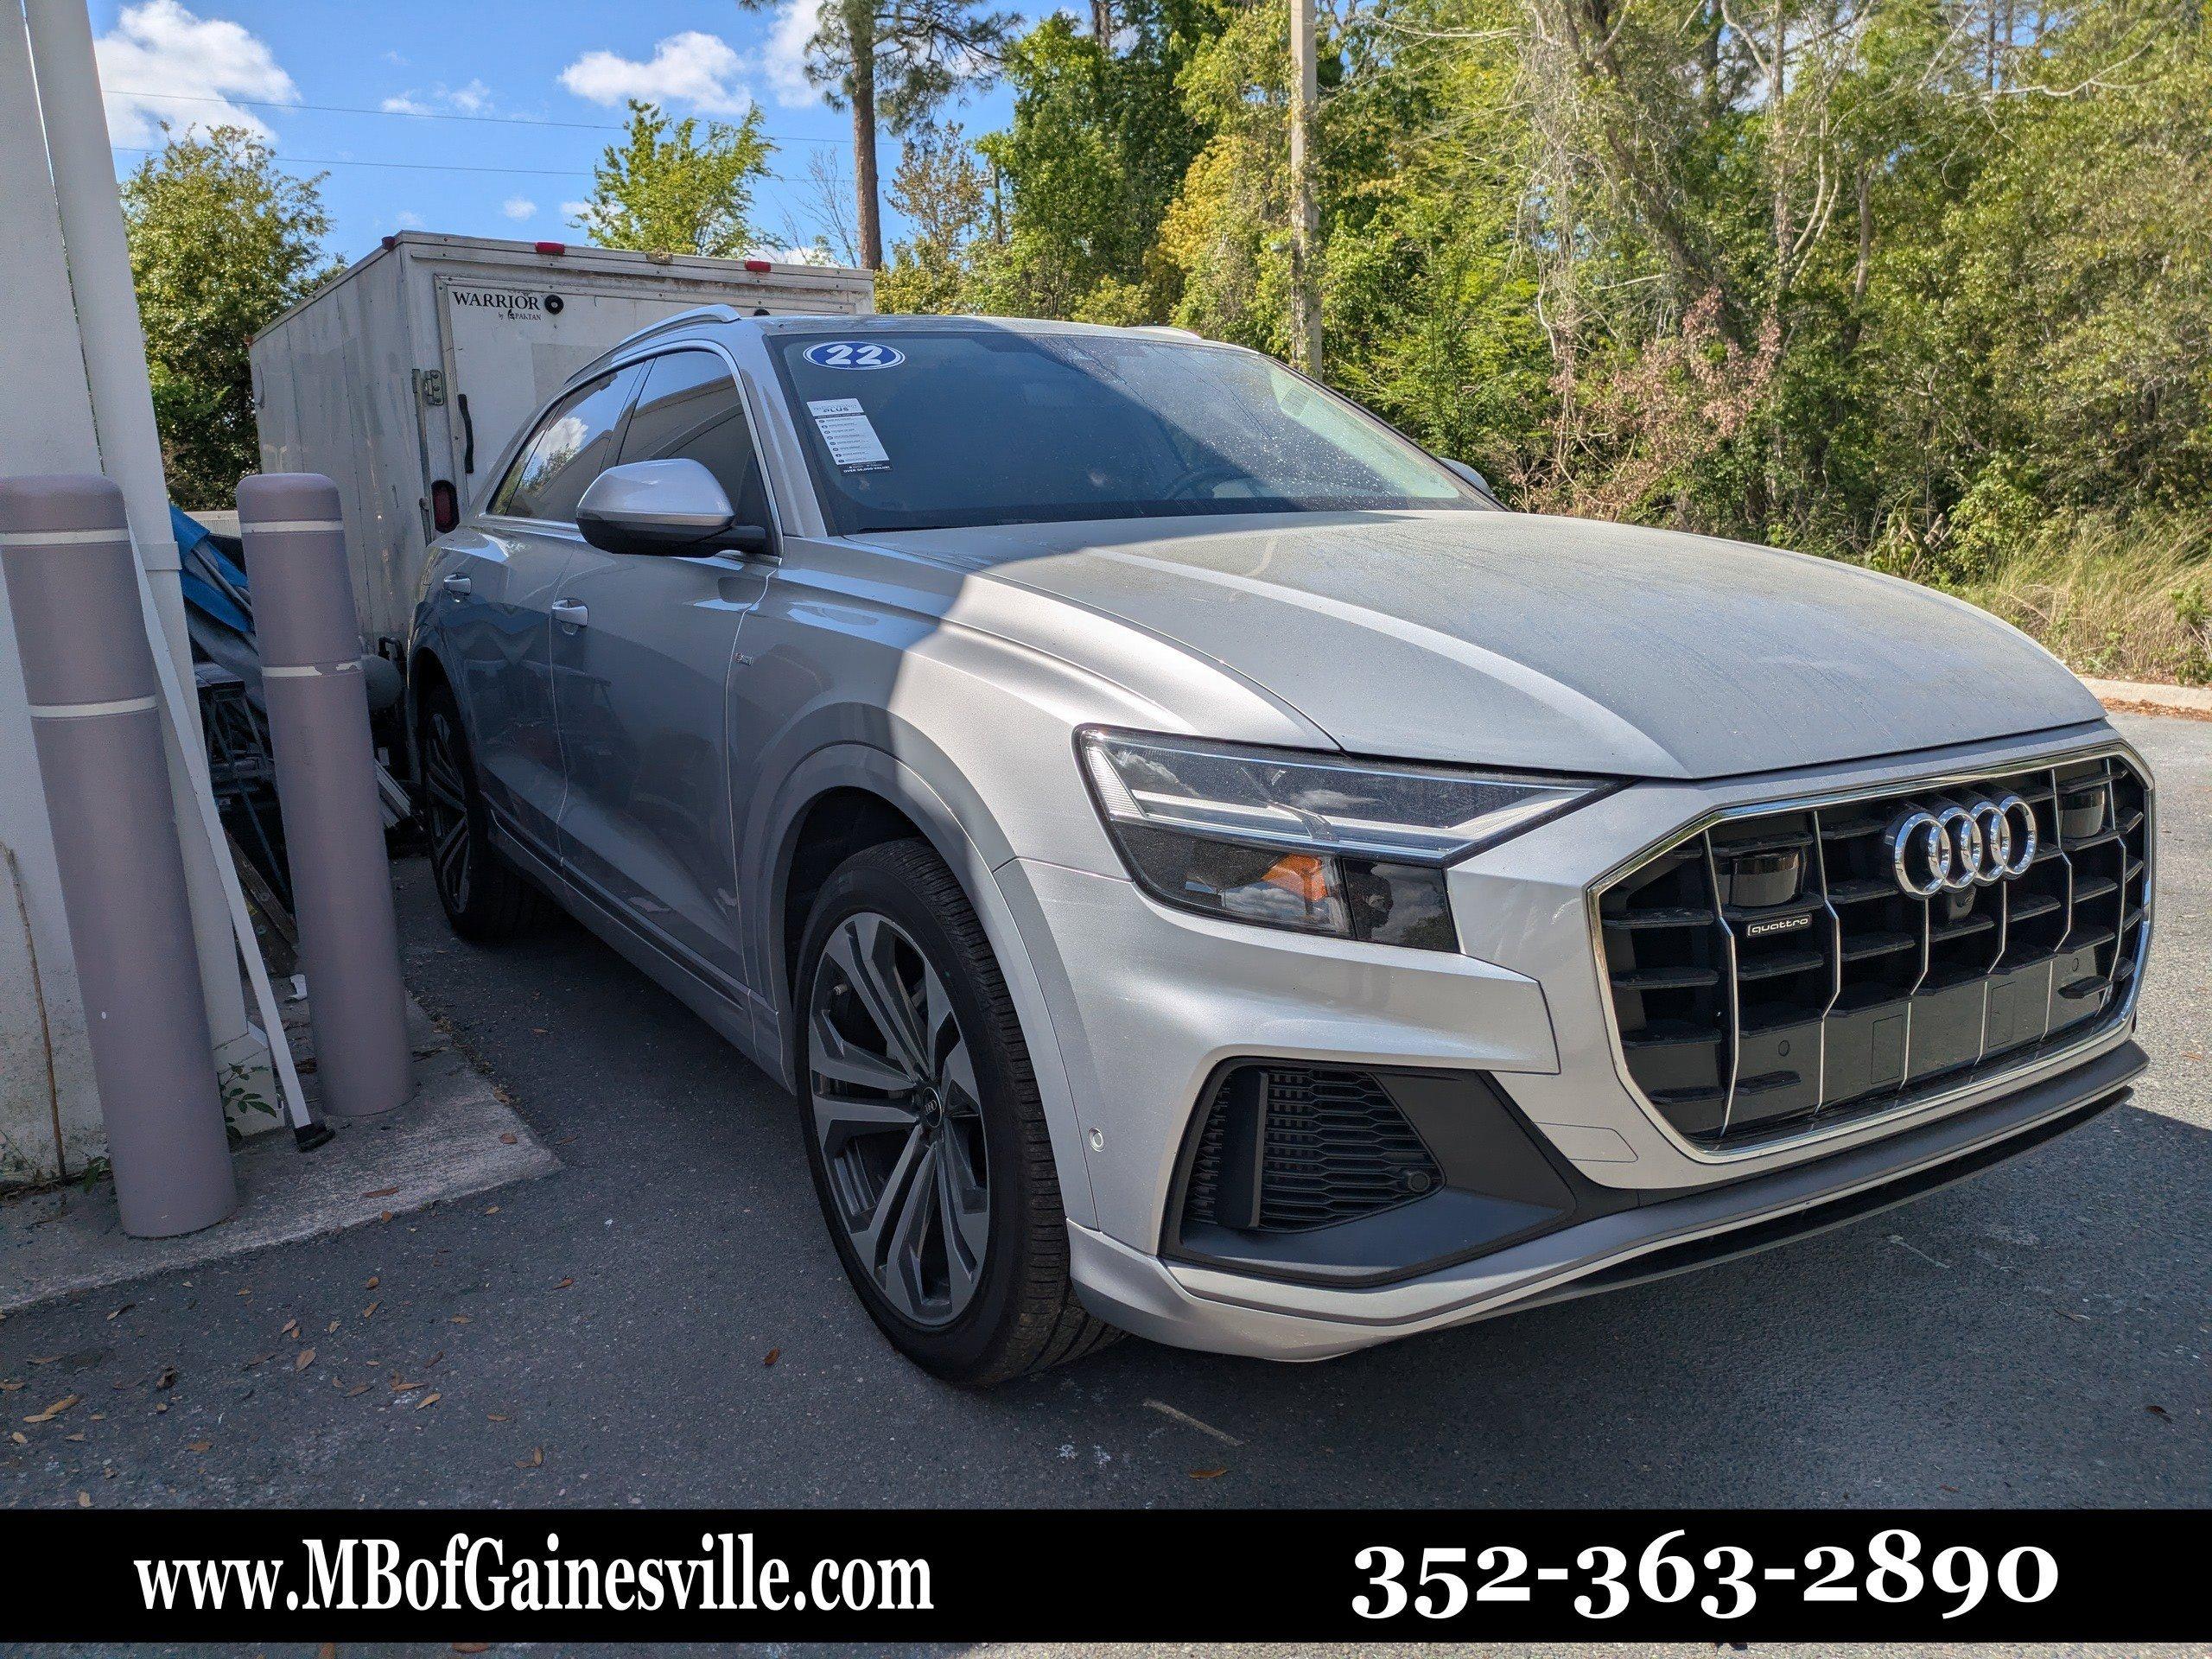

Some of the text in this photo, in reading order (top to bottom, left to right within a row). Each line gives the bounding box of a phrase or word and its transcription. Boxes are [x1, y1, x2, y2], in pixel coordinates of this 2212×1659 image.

[452, 291, 541, 311] WARRIOR
[507, 308, 542, 321] SPARTAN
[825, 345, 883, 365] 22
[1751, 918, 1808, 933] quattro
